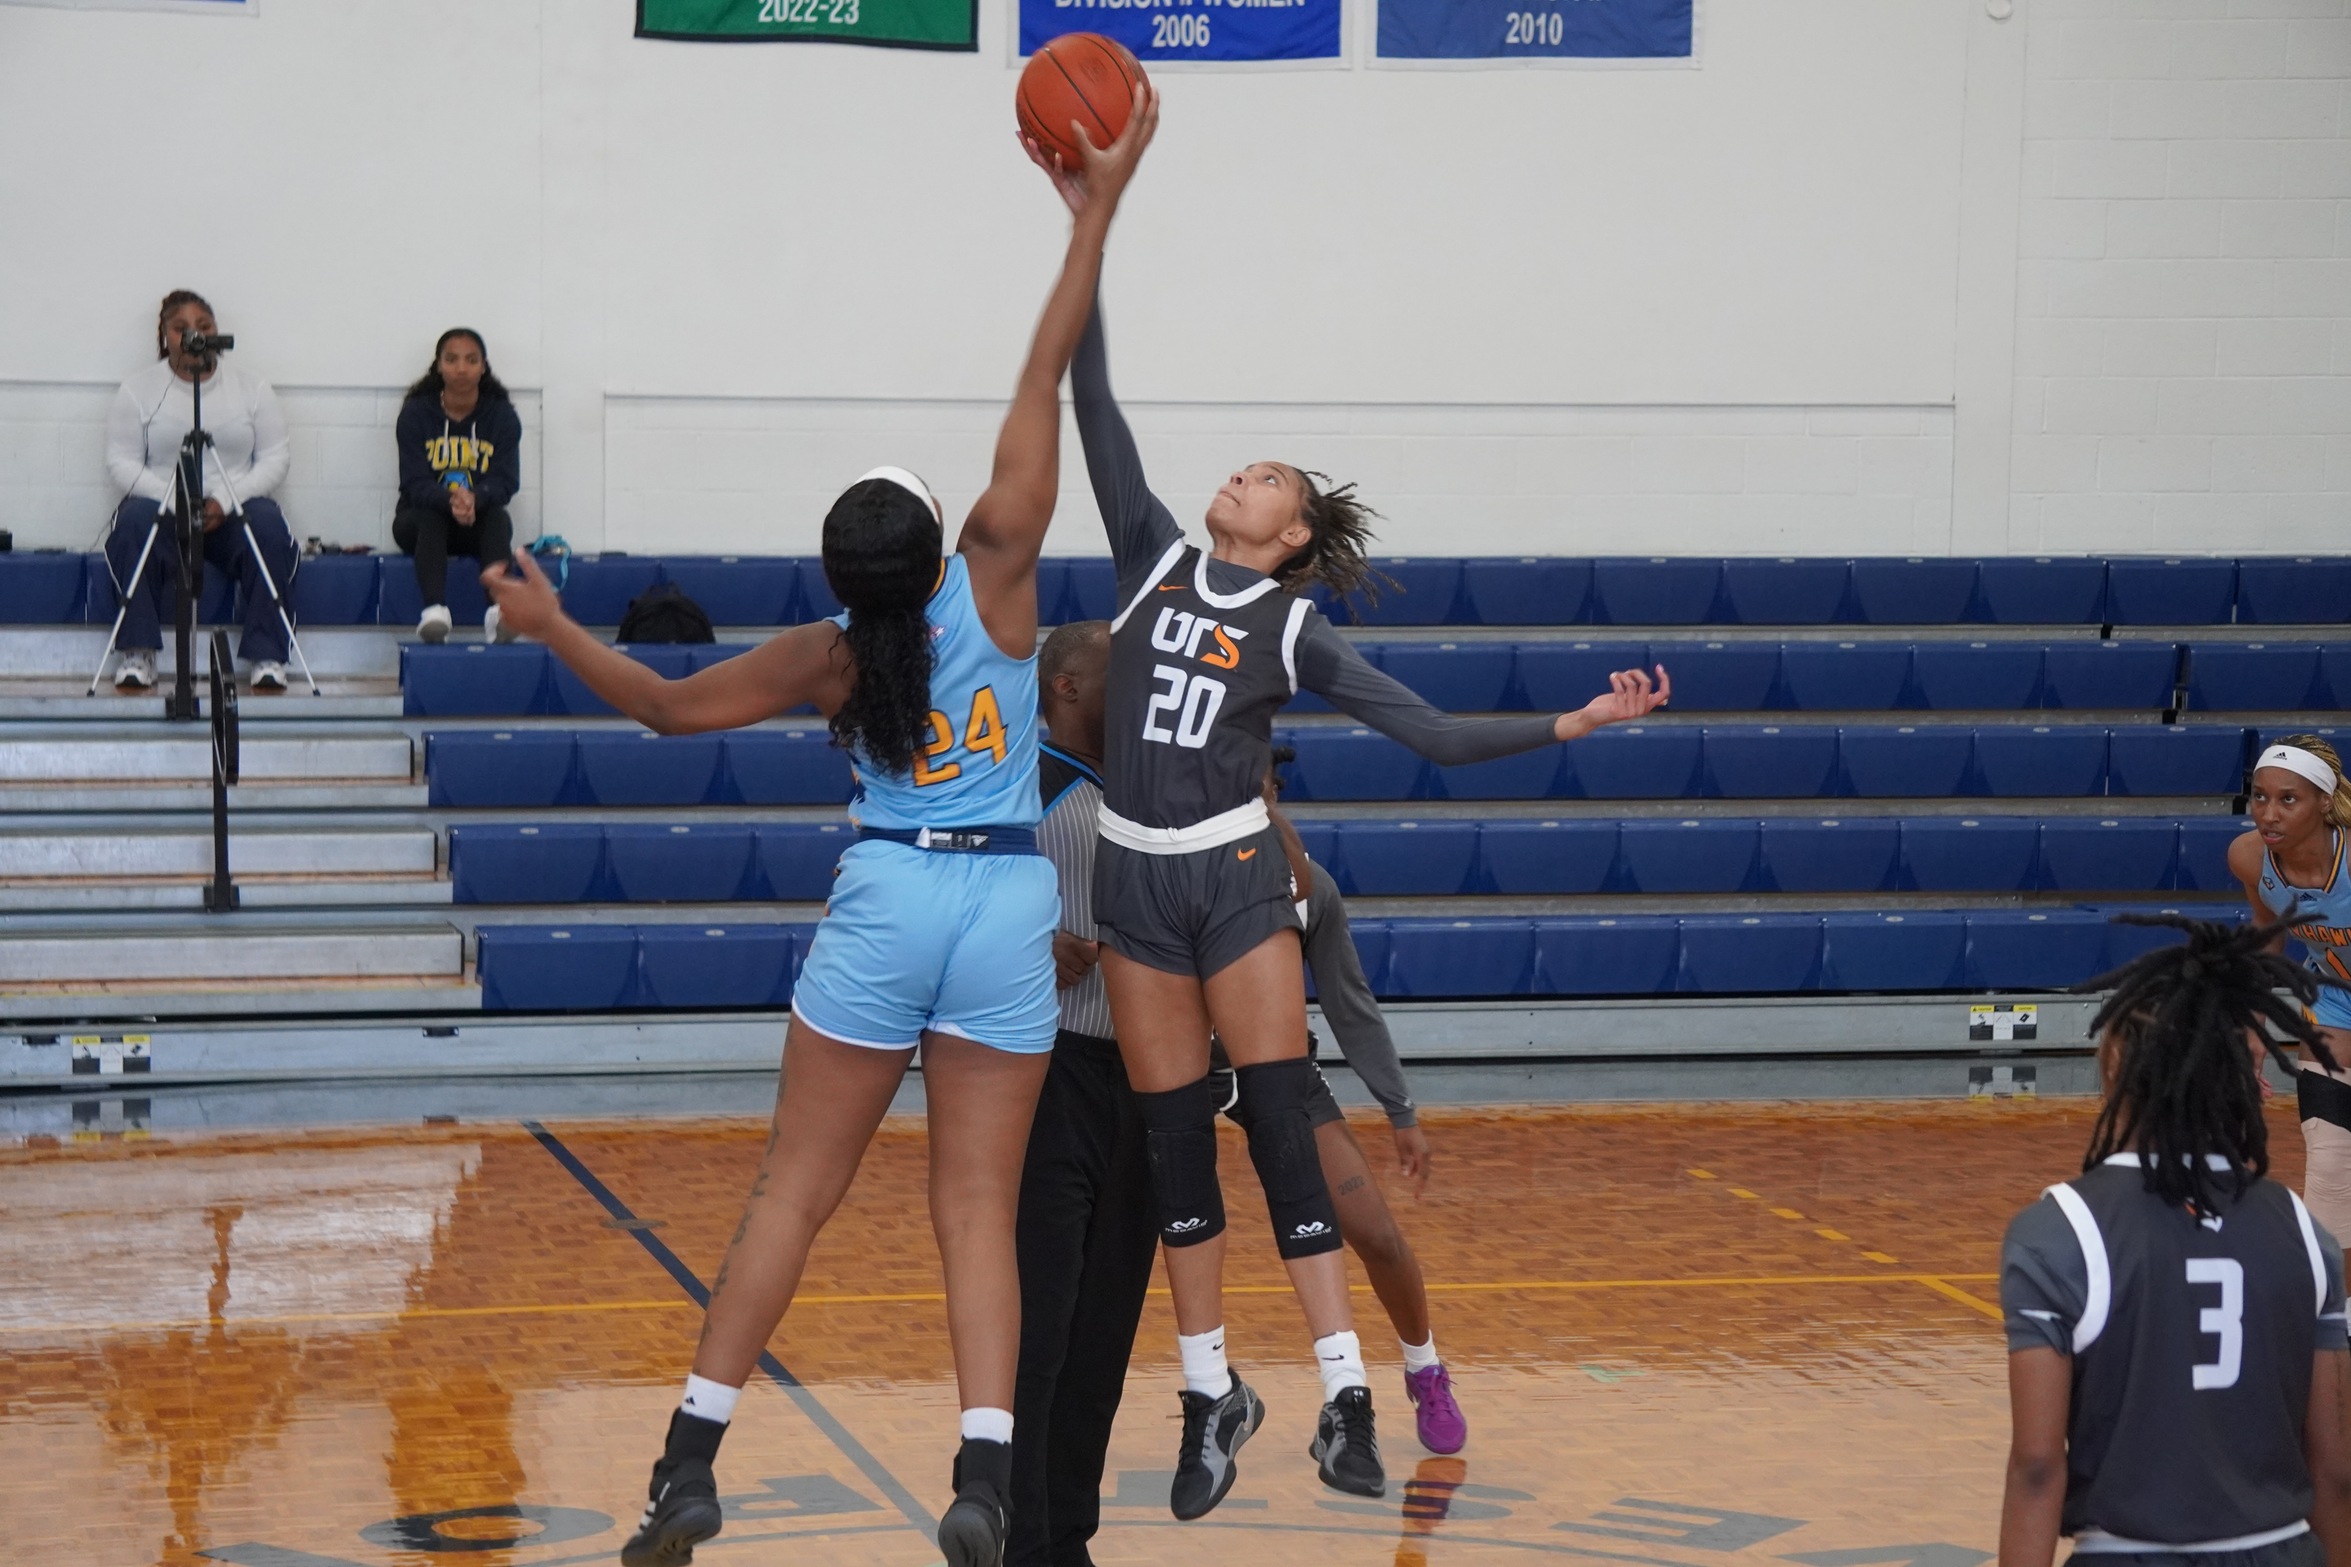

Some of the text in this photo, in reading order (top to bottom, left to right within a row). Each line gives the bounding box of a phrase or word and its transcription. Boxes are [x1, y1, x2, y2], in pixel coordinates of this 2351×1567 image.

[757, 0, 860, 25] 2022-23
[1152, 14, 1210, 47] 2006
[1505, 12, 1563, 45] 2010
[913, 684, 1008, 787] 24
[1142, 664, 1226, 749] 20
[2186, 1258, 2244, 1390] 3
